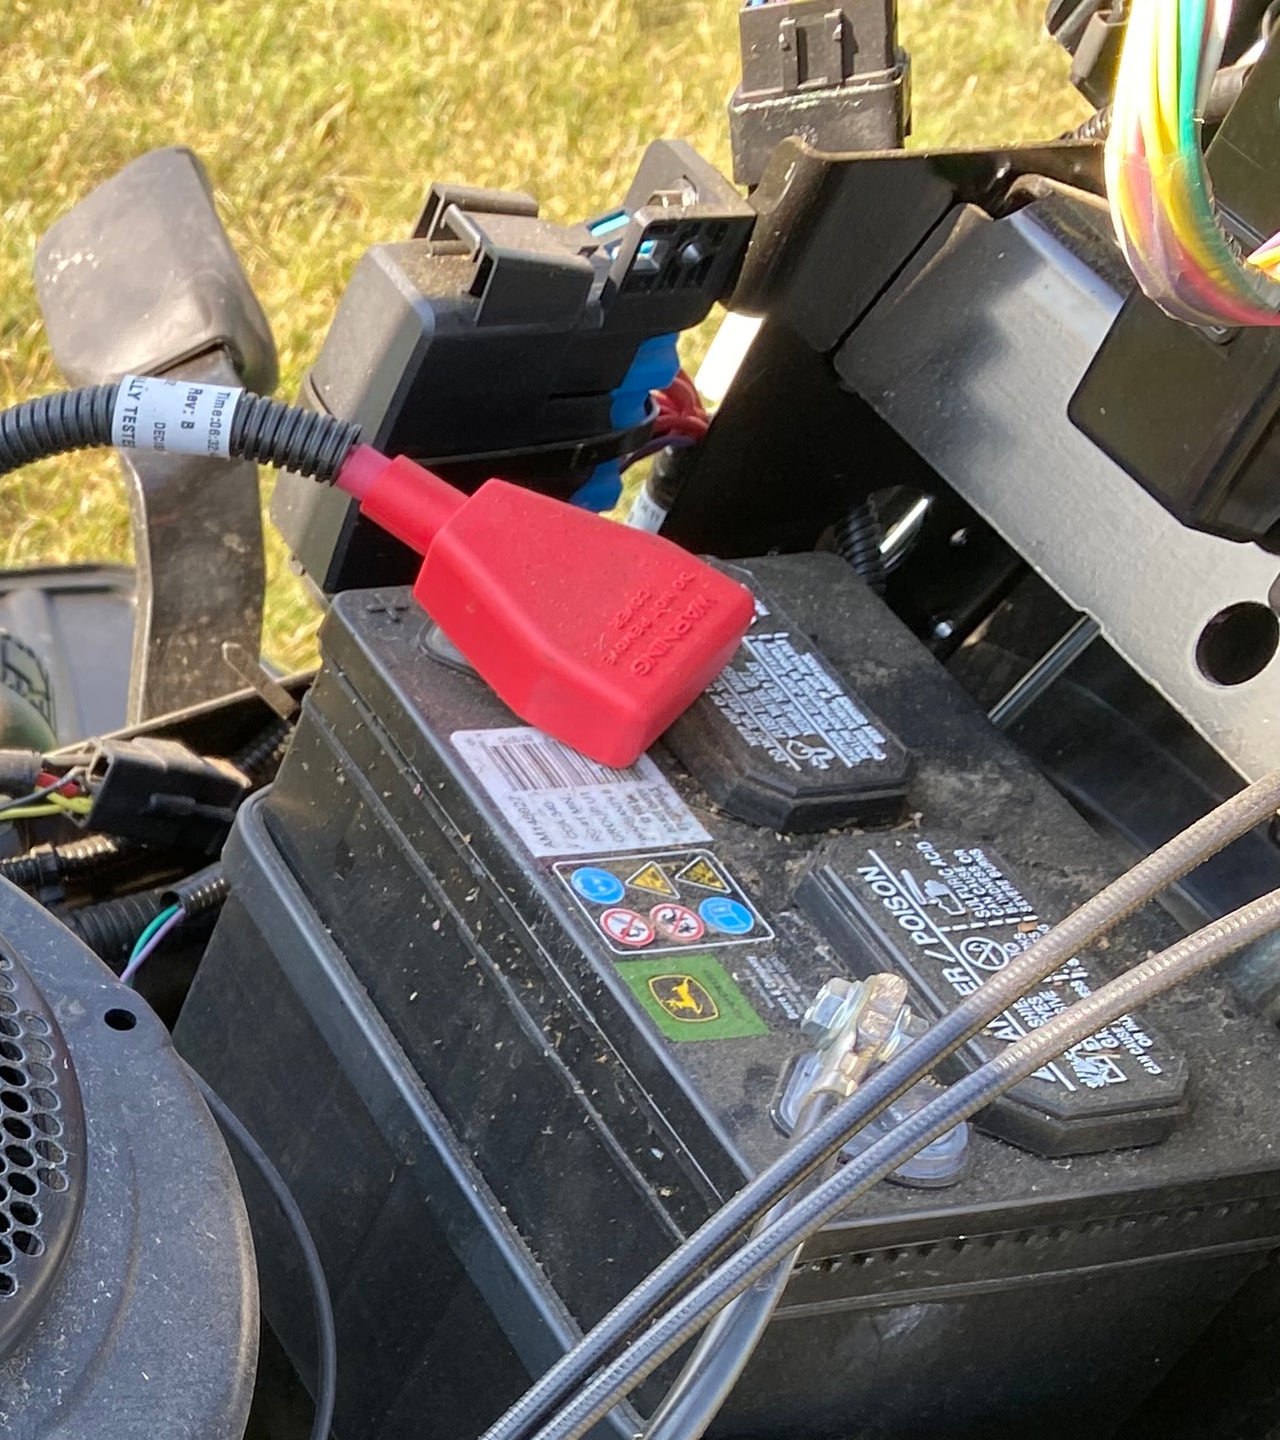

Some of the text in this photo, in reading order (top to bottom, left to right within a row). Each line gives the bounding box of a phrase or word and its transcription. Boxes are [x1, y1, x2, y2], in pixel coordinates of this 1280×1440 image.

[180, 420, 195, 429] B
[624, 592, 721, 678] WARNING
[852, 864, 942, 946] POISON
[911, 839, 993, 919] SULFURIC ACID
[951, 865, 1007, 916] CAN CAUSE
